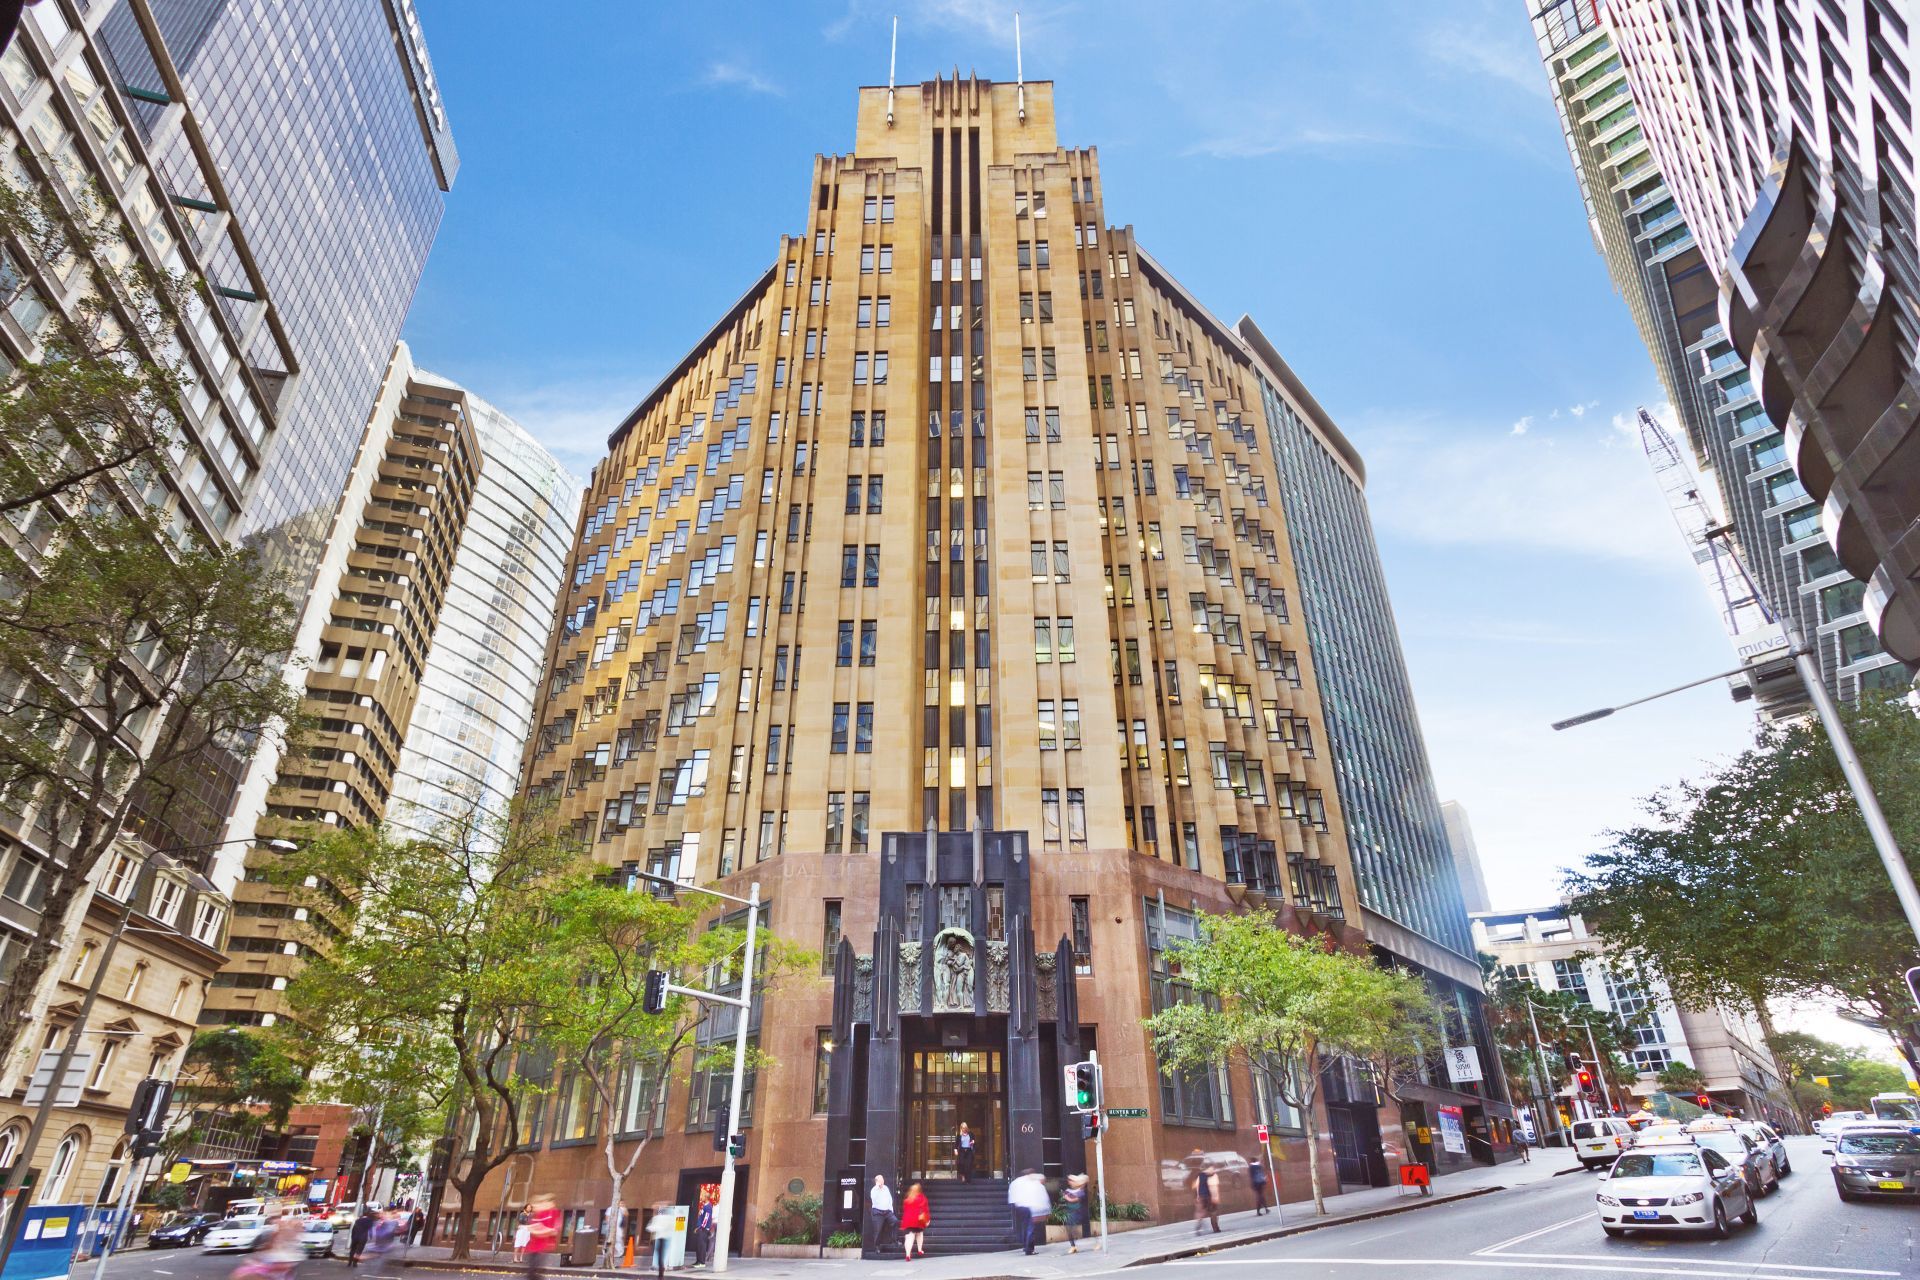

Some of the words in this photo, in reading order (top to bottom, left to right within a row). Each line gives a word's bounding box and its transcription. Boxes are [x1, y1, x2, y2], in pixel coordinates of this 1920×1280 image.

[1738, 635, 1786, 657] mirva
[1455, 1063, 1471, 1071] SUSHI
[1021, 1122, 1034, 1134] 66
